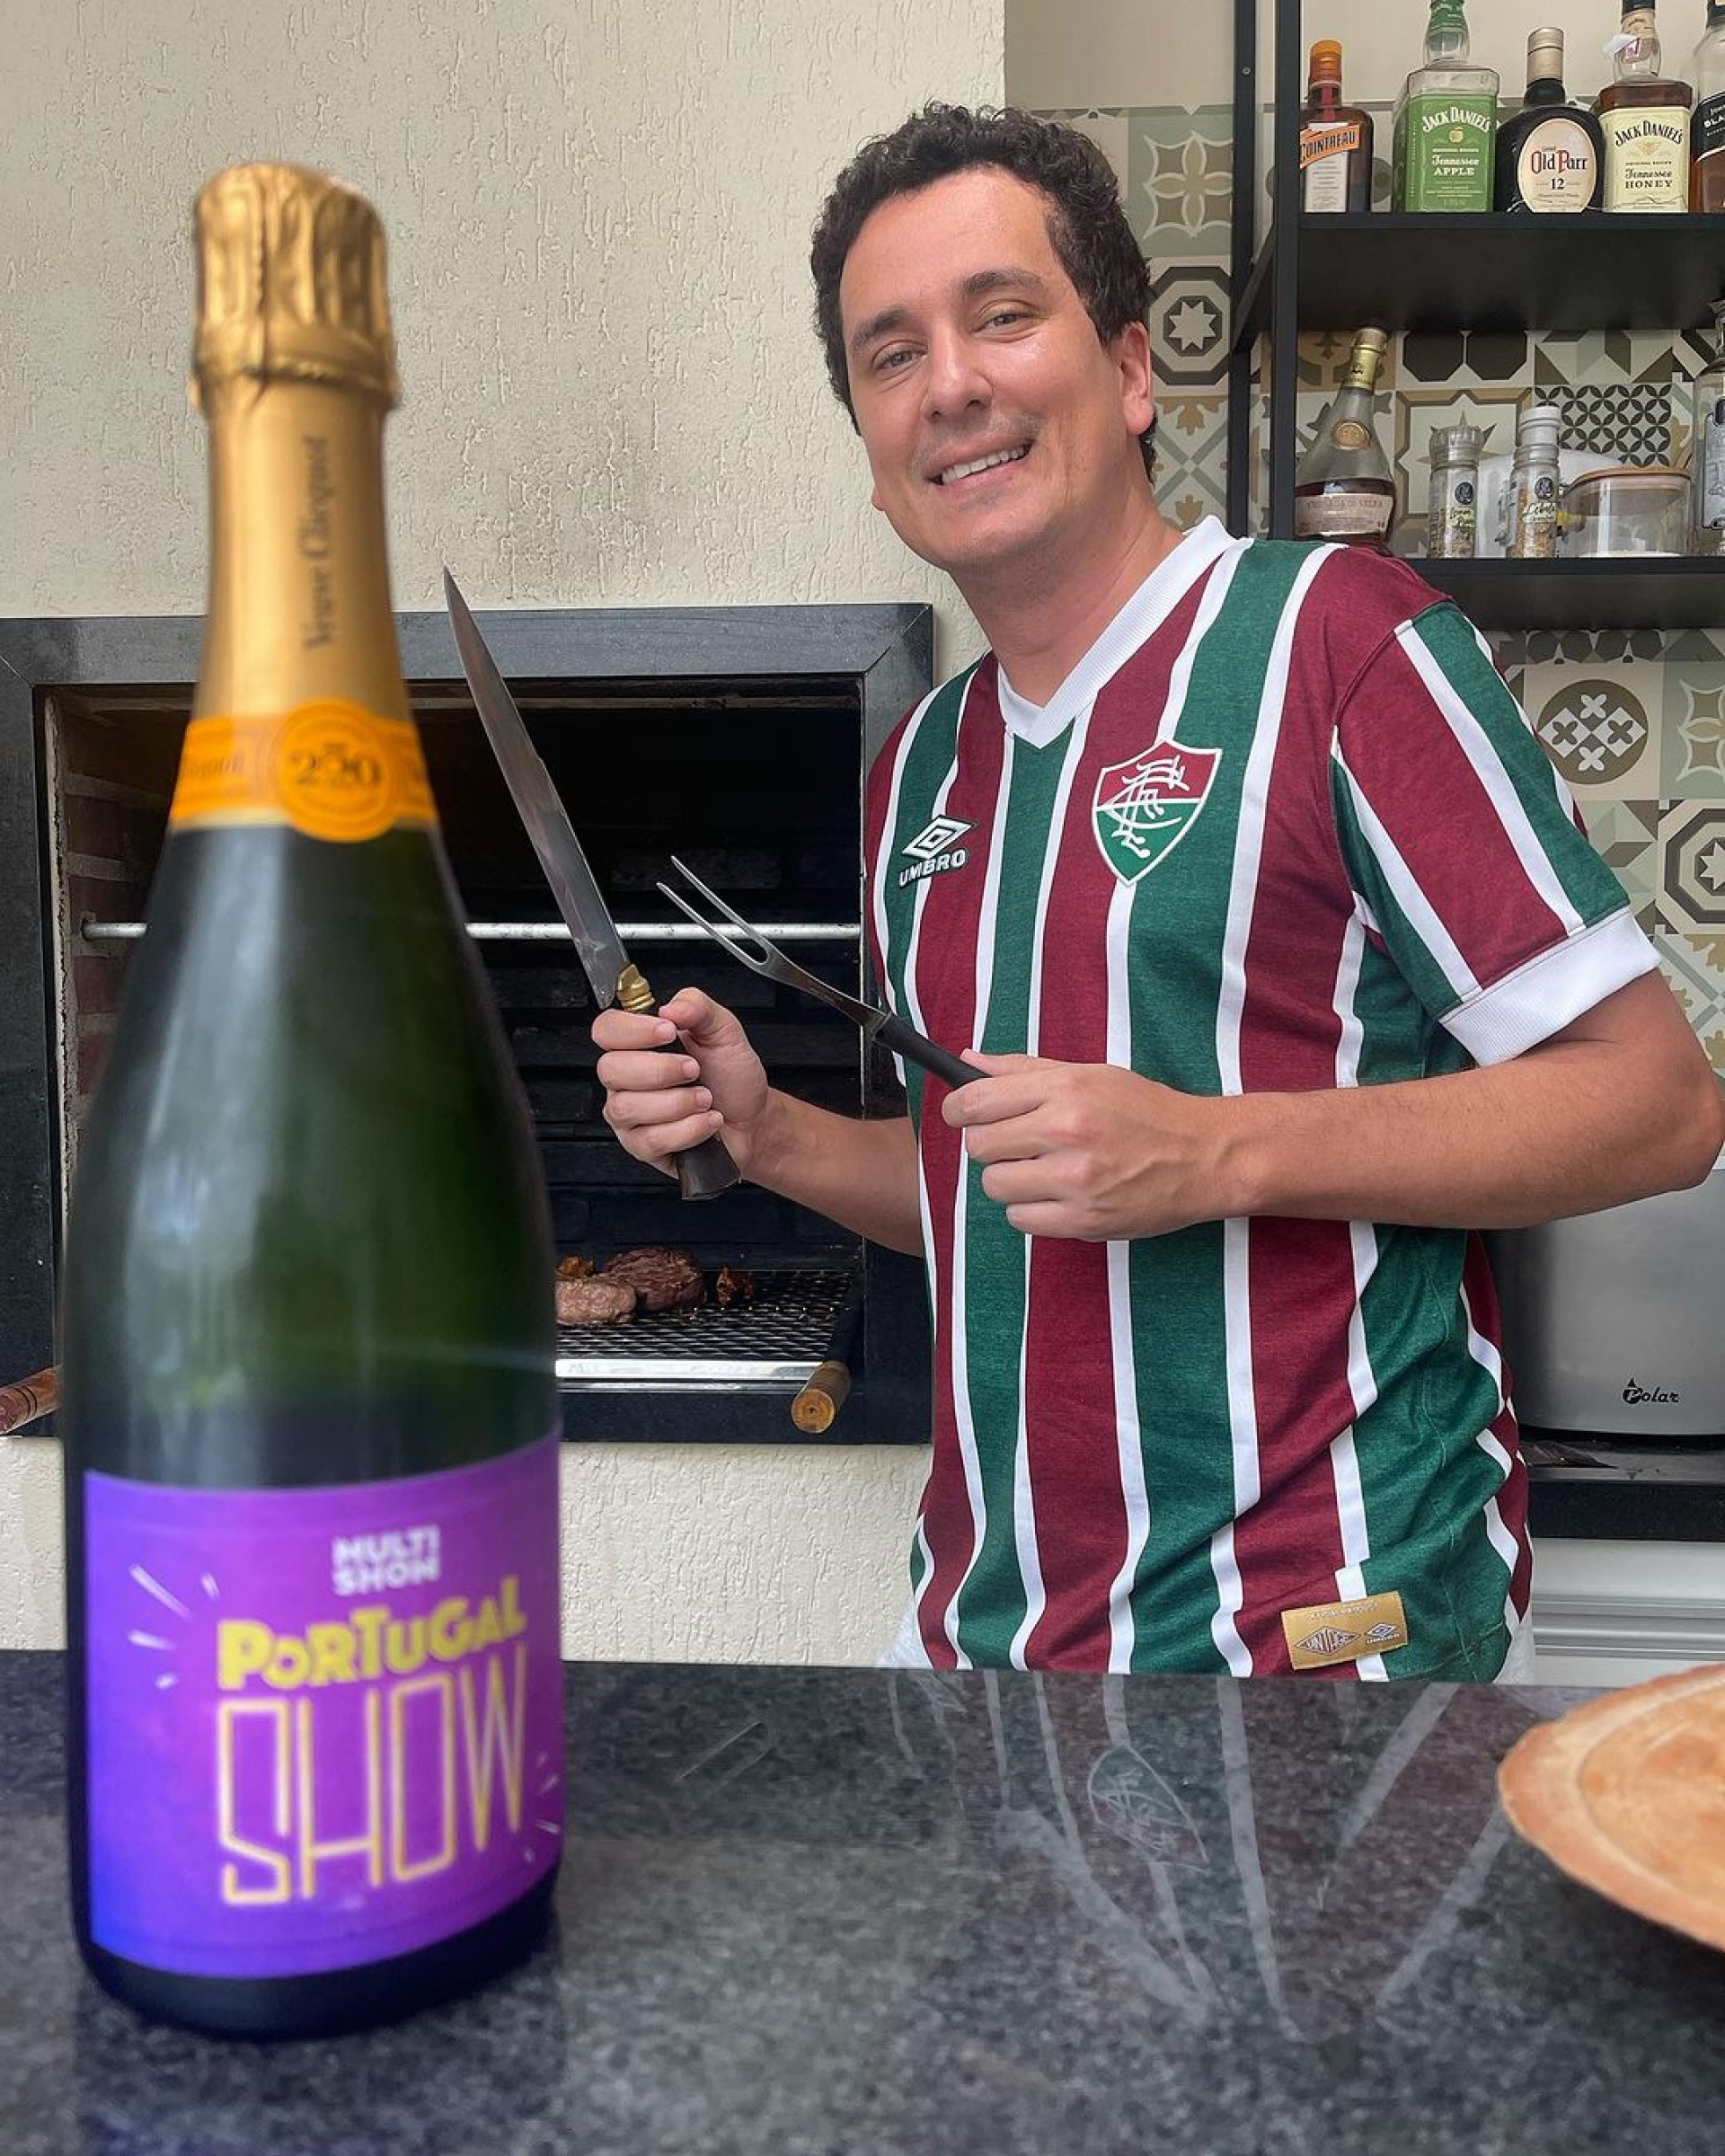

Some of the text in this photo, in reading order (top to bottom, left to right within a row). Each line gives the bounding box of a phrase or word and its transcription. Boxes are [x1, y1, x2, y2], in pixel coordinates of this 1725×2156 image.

[1422, 110, 1449, 133] JACK
[1614, 124, 1641, 147] JACK
[1434, 167, 1475, 175] APPLE
[1531, 149, 1588, 174] Old Parr
[1551, 178, 1565, 190] 12
[1625, 180, 1673, 190] HONEY
[899, 849, 966, 887] UMBRO
[217, 1642, 527, 1904] SHOW
